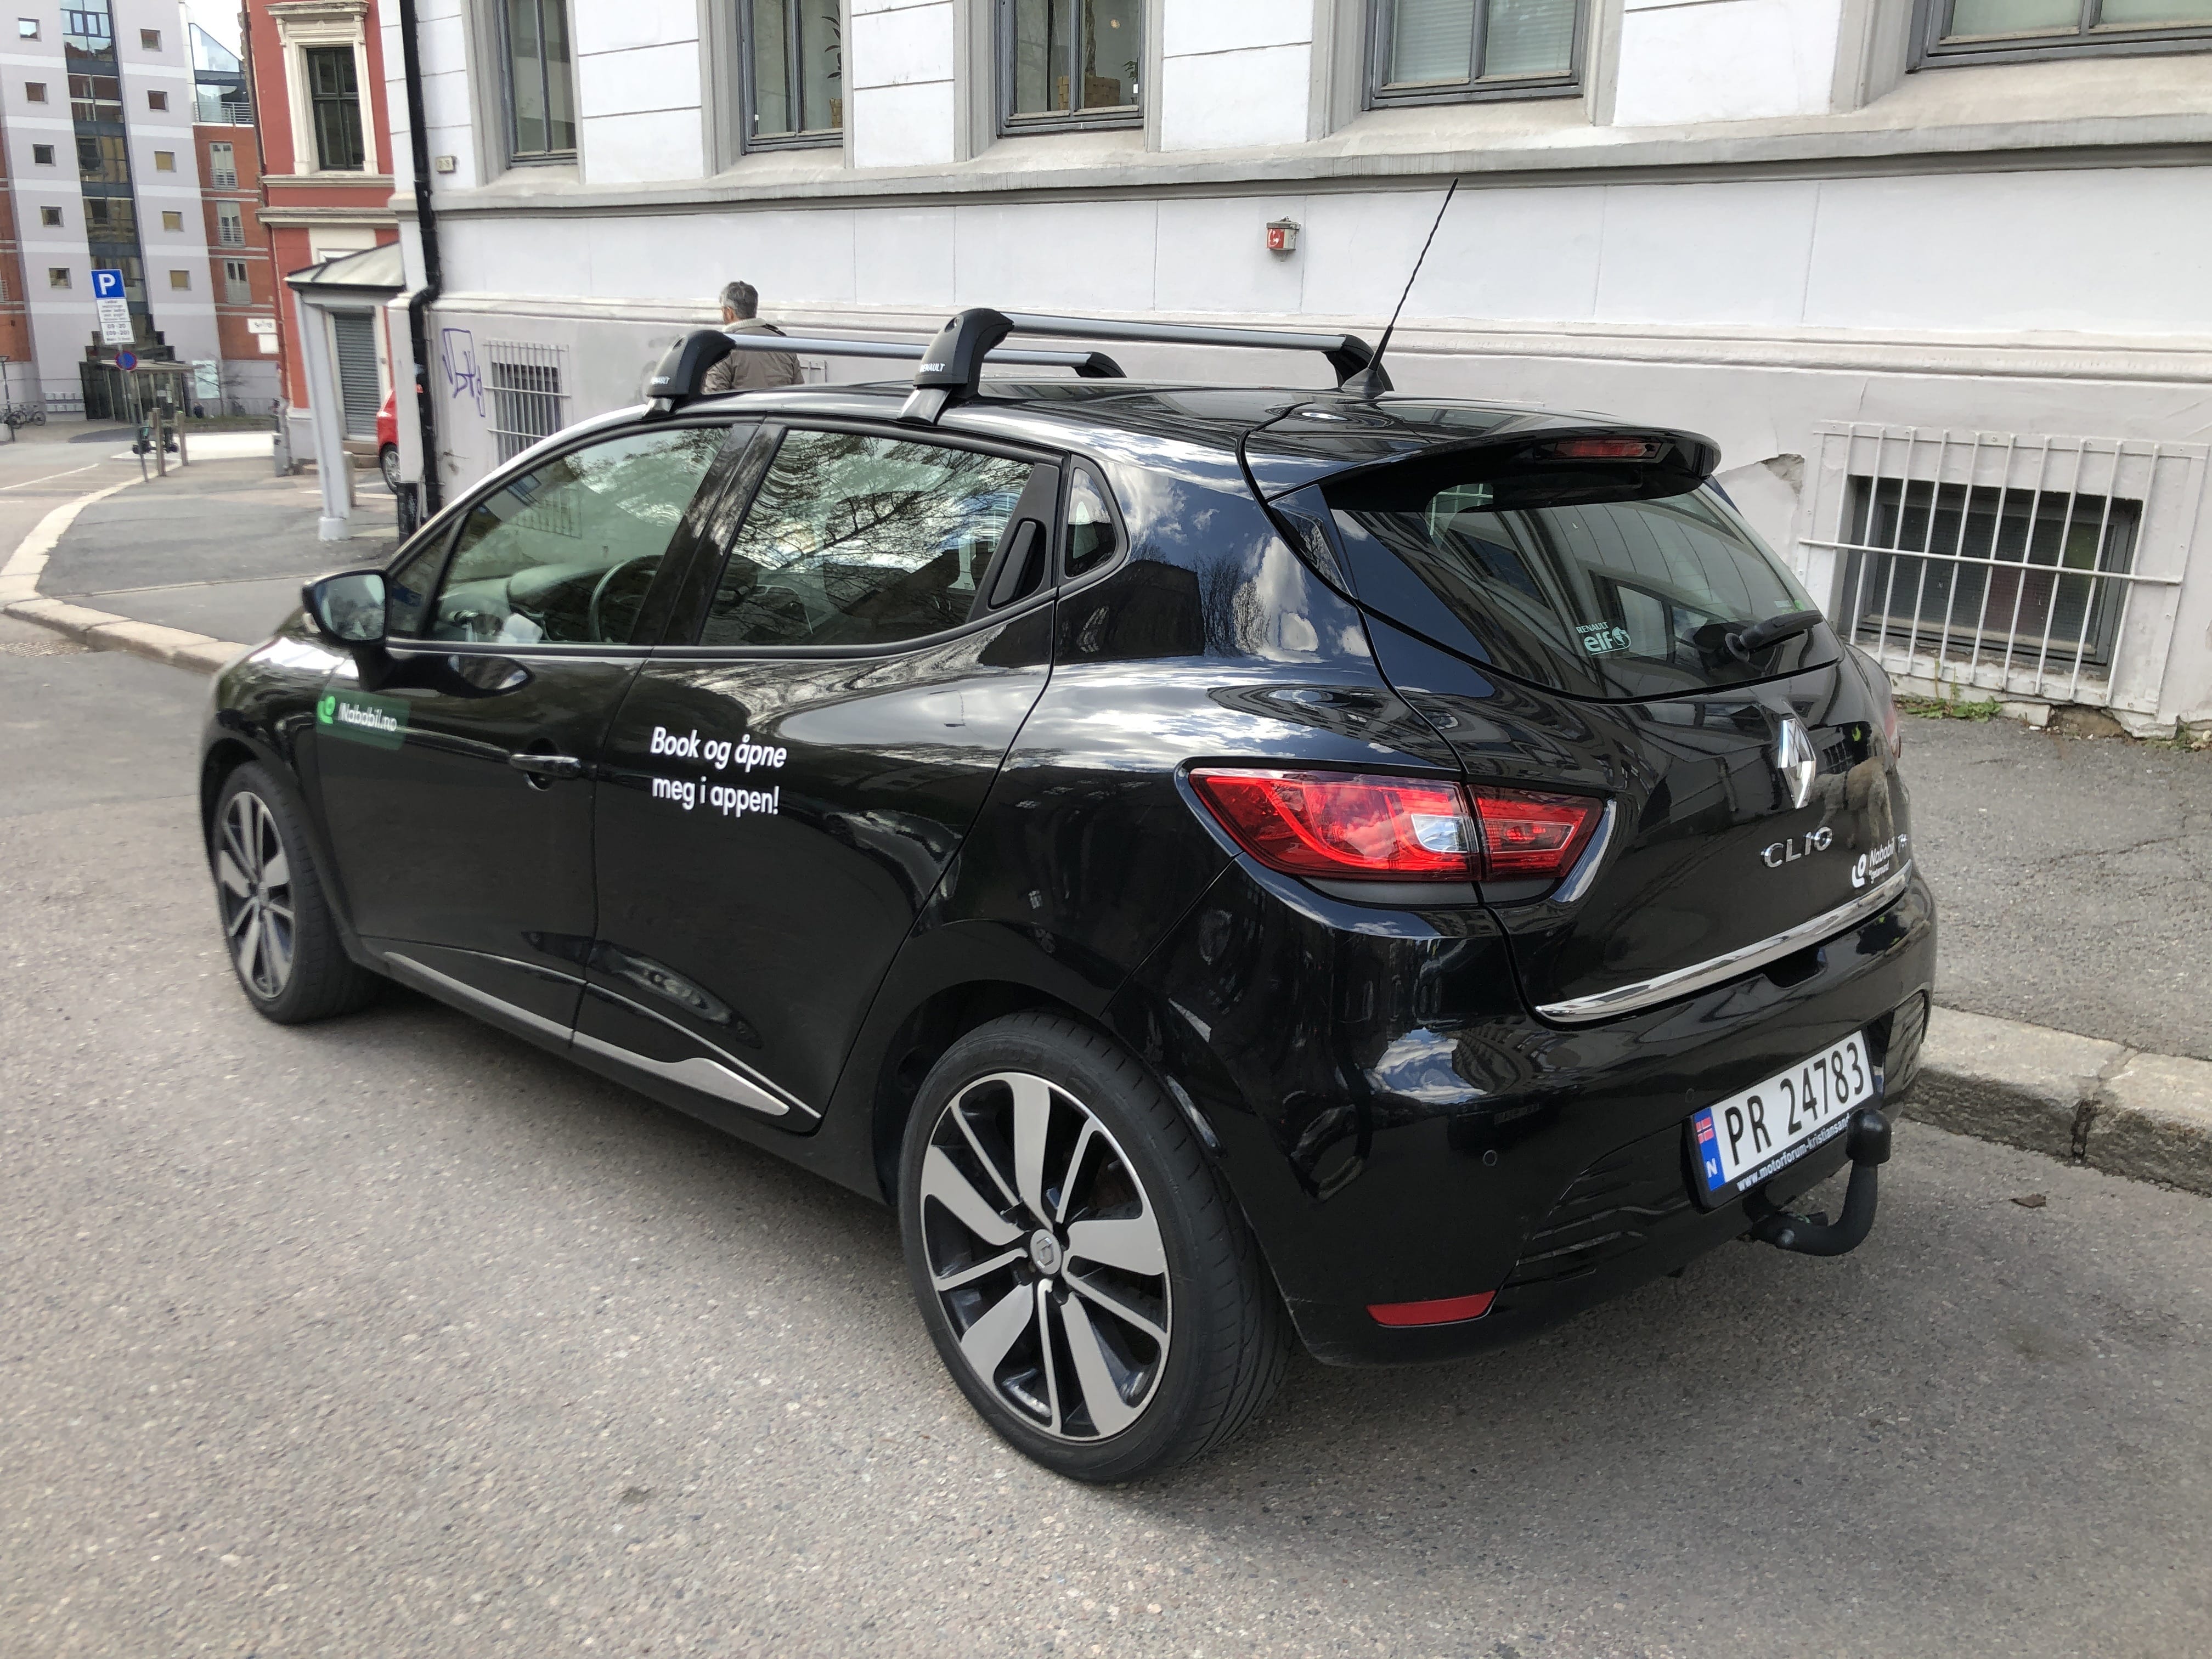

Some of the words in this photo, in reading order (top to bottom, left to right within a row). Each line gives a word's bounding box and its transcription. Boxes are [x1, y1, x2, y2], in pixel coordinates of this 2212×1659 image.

[98, 273, 116, 295] P
[1576, 622, 1609, 634] RENAULT
[1584, 631, 1613, 652] elf
[338, 702, 397, 731] Nabobil.no
[650, 726, 701, 758] Book
[704, 740, 732, 770] og
[734, 733, 787, 773] åpne
[652, 778, 696, 810] meg
[700, 776, 707, 804] i
[710, 786, 780, 817] appen!
[1760, 826, 1832, 868] CLIO
[1724, 1095, 1772, 1166] PR
[1780, 1042, 1864, 1136] 24783
[1705, 1158, 1718, 1178] N
